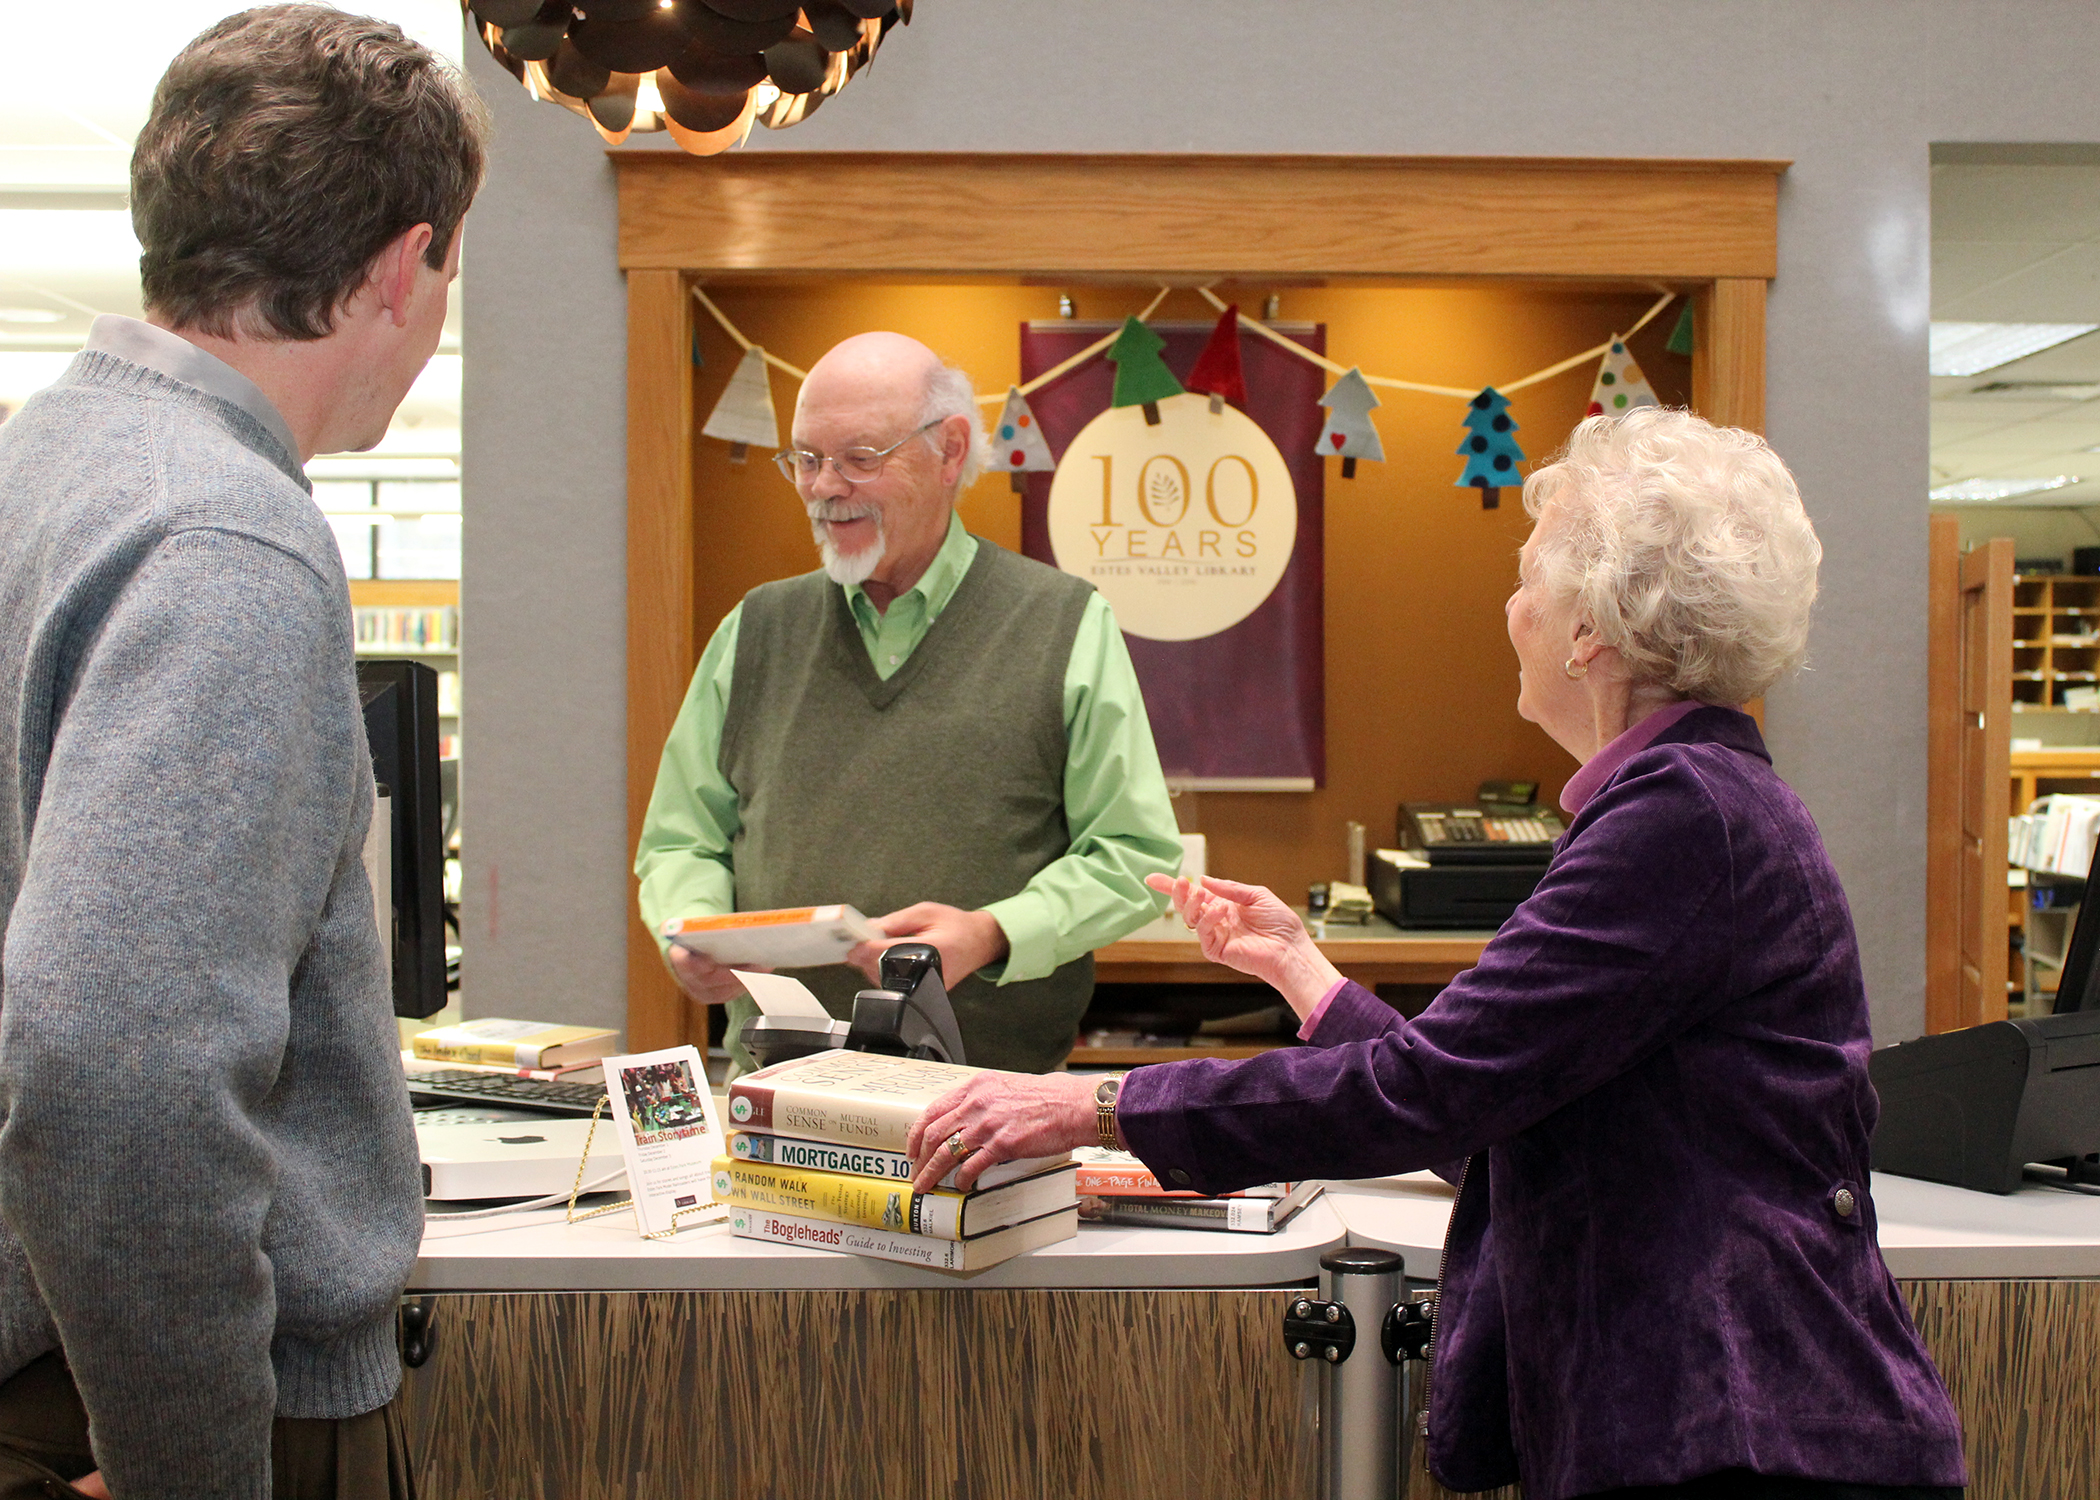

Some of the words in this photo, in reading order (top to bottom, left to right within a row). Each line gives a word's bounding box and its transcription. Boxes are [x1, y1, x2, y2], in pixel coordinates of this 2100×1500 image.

[1090, 454, 1259, 528] 100
[1090, 530, 1257, 558] YEARS
[1091, 566, 1132, 576] ESTES
[1137, 566, 1189, 576] VALLEY
[1195, 566, 1257, 576] LIBRARY
[802, 1057, 905, 1087] SENSE
[850, 1065, 951, 1094] MUTUAL
[879, 1071, 970, 1095] FUNDS
[786, 1105, 828, 1118] COMMON
[840, 1113, 879, 1126] MUTUAL
[786, 1114, 826, 1131] SENSE
[839, 1123, 879, 1137] FUNDS
[635, 1133, 657, 1146] Train
[657, 1125, 707, 1142] Storytime
[781, 1145, 885, 1175] MORTGAGES
[891, 1159, 914, 1179] 10
[735, 1171, 776, 1188] RANDOM
[780, 1178, 808, 1193] WALK
[1085, 1175, 1135, 1189] ONE-PAGE
[1137, 1175, 1161, 1188] FINA
[750, 1190, 776, 1204] WALL
[779, 1194, 816, 1210] STREET
[1123, 1204, 1149, 1214] TOTAL
[1150, 1204, 1190, 1216] MONEY
[1189, 1206, 1229, 1218] MAKEOV
[772, 1219, 844, 1246] Bogleheads'
[846, 1235, 875, 1250] Guide
[876, 1243, 887, 1252] to
[888, 1241, 933, 1263] Investing
